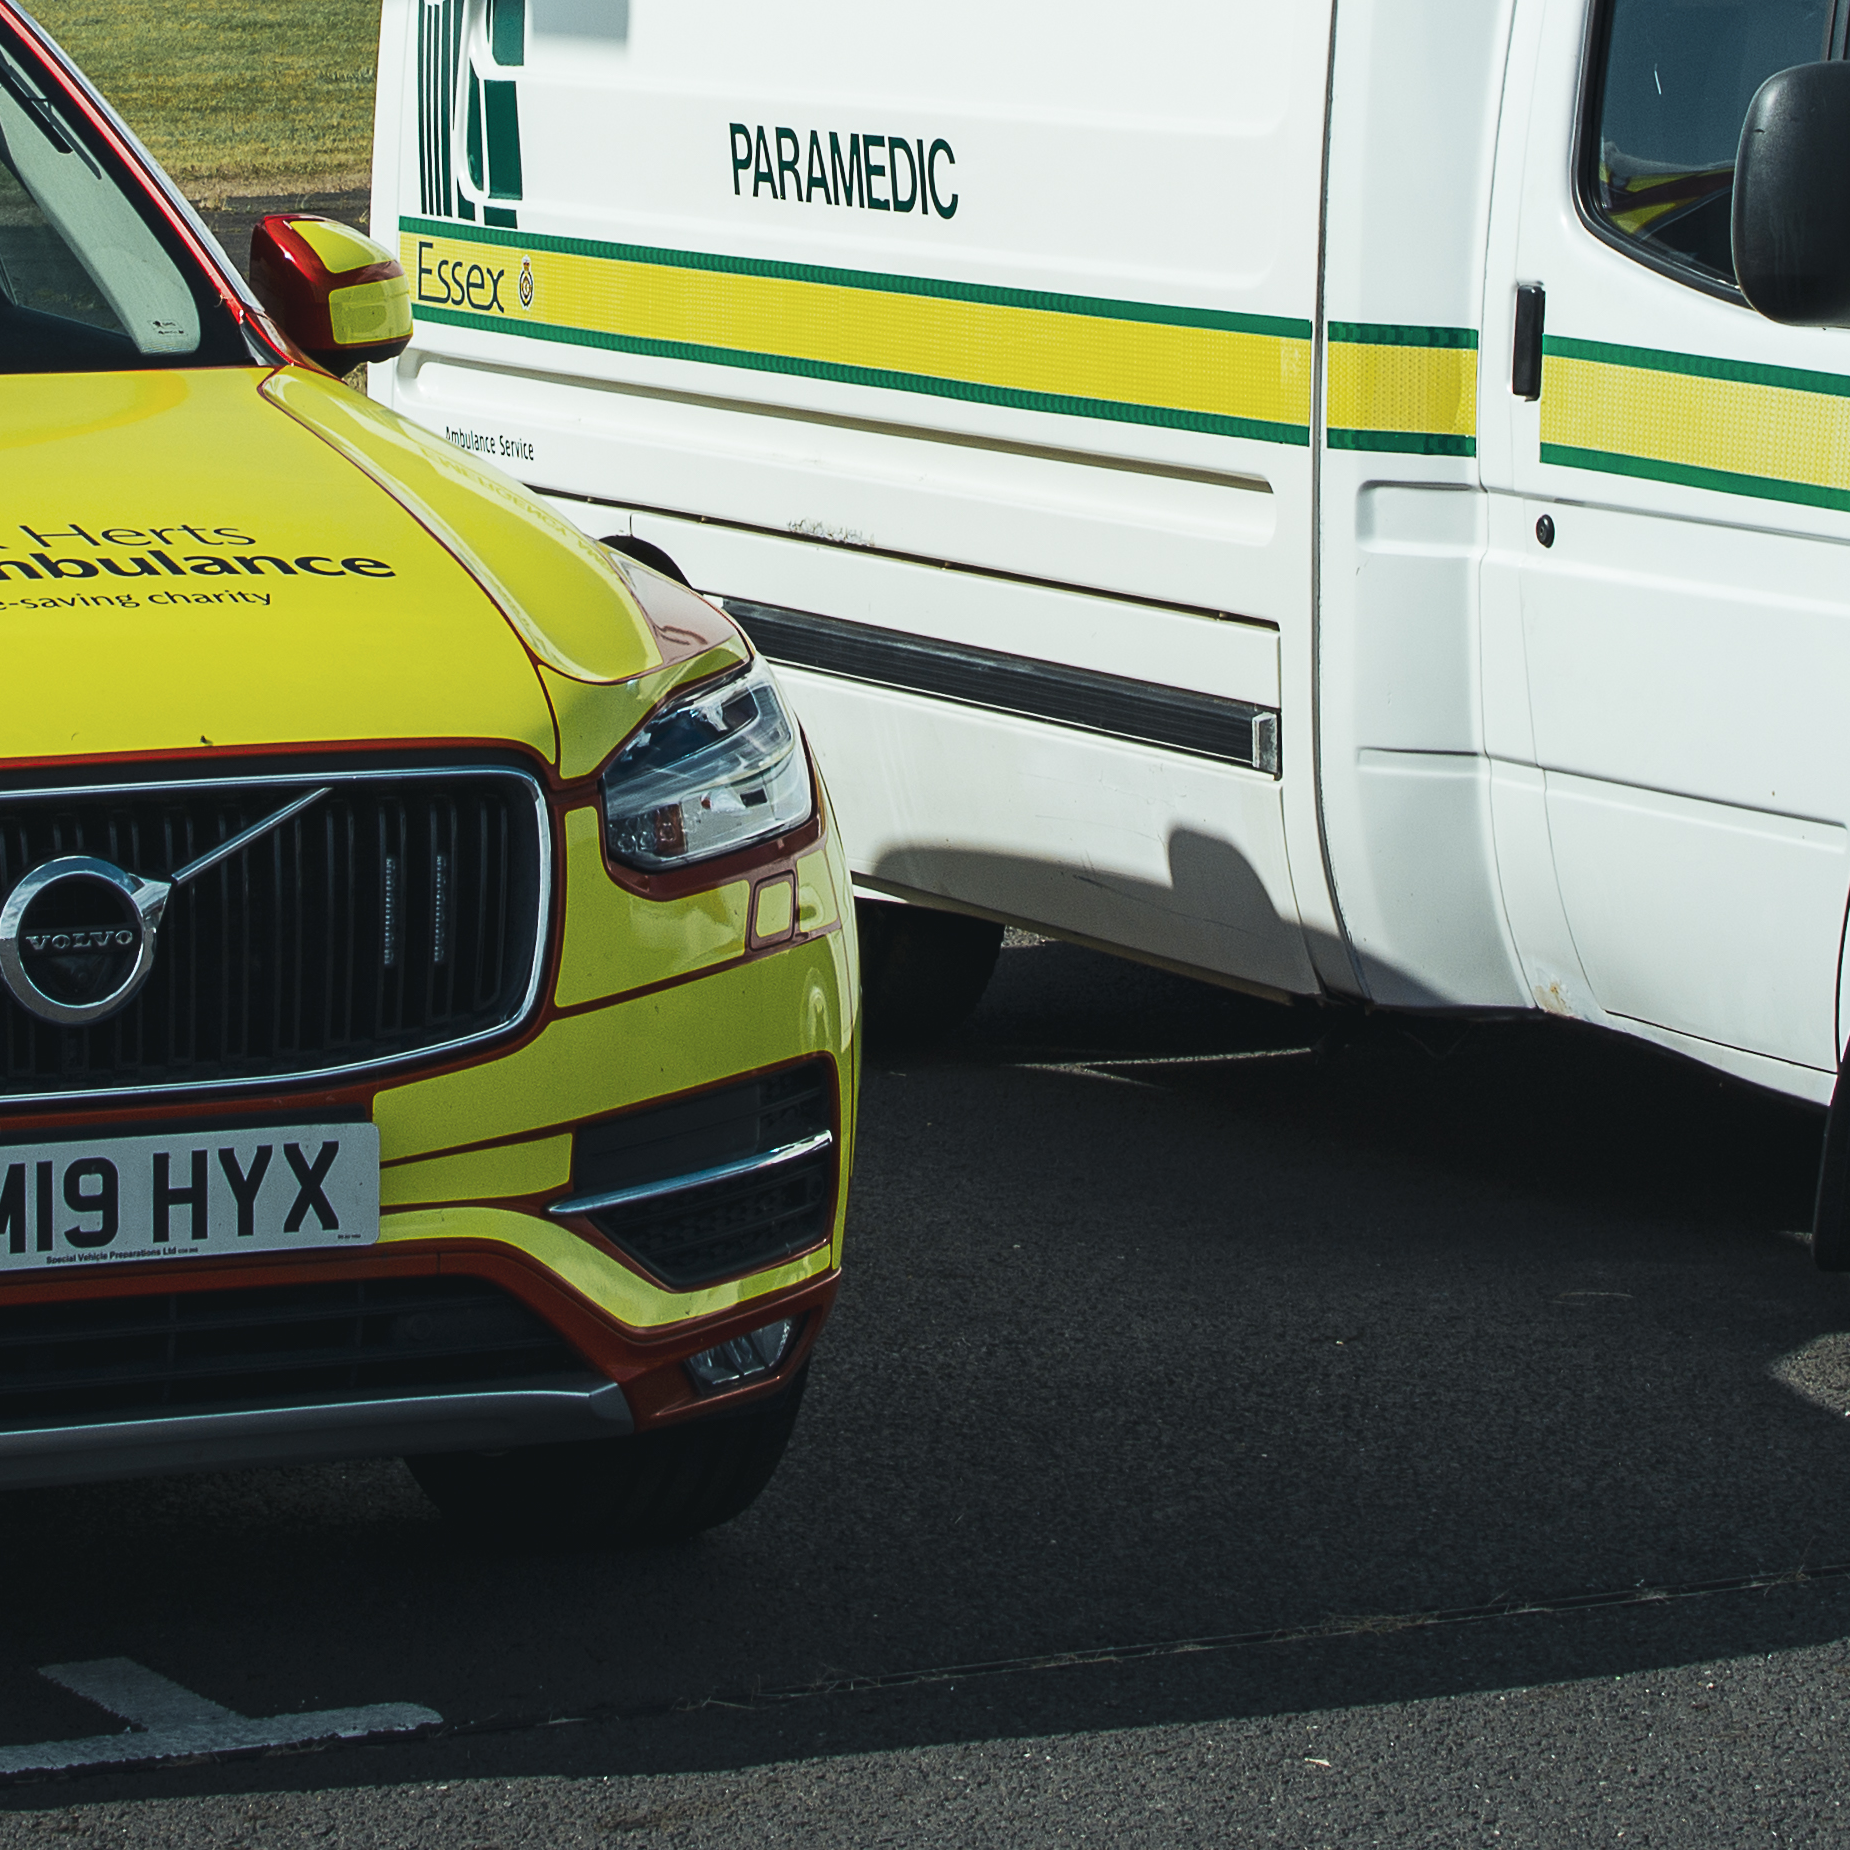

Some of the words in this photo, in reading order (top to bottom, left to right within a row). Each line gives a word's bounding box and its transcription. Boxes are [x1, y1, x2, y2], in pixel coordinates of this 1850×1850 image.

[729, 122, 959, 220] PARAMEDIC
[417, 240, 506, 315] Essex
[445, 425, 496, 454] Ambulance
[499, 434, 534, 461] Service
[18, 523, 257, 549] Herts
[146, 589, 272, 607] charity
[25, 929, 134, 951] VOLVO
[152, 1140, 340, 1244] HYX
[46, 1252, 77, 1265] Special
[78, 1250, 108, 1262] Vehicle
[109, 1247, 162, 1260] Preparations
[163, 1245, 177, 1256] Ltd
